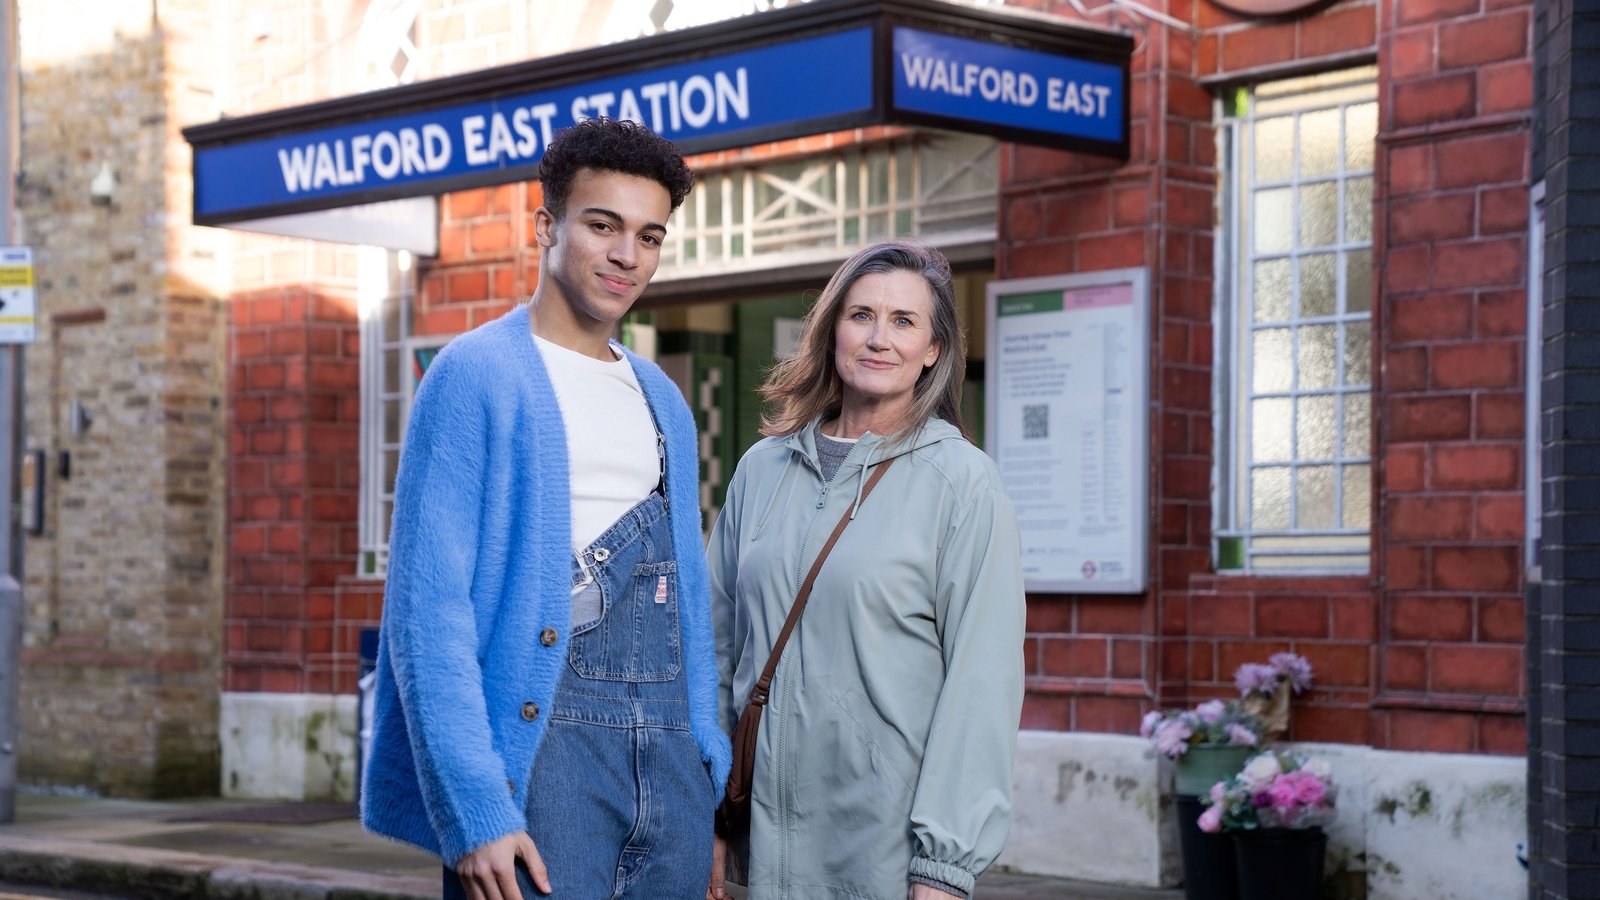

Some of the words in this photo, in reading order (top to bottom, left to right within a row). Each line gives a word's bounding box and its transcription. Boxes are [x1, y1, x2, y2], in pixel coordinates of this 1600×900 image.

[902, 53, 1038, 106] WALFORD
[1047, 78, 1111, 118] EAST
[278, 124, 452, 193] WALFORD
[462, 103, 557, 166] EAST
